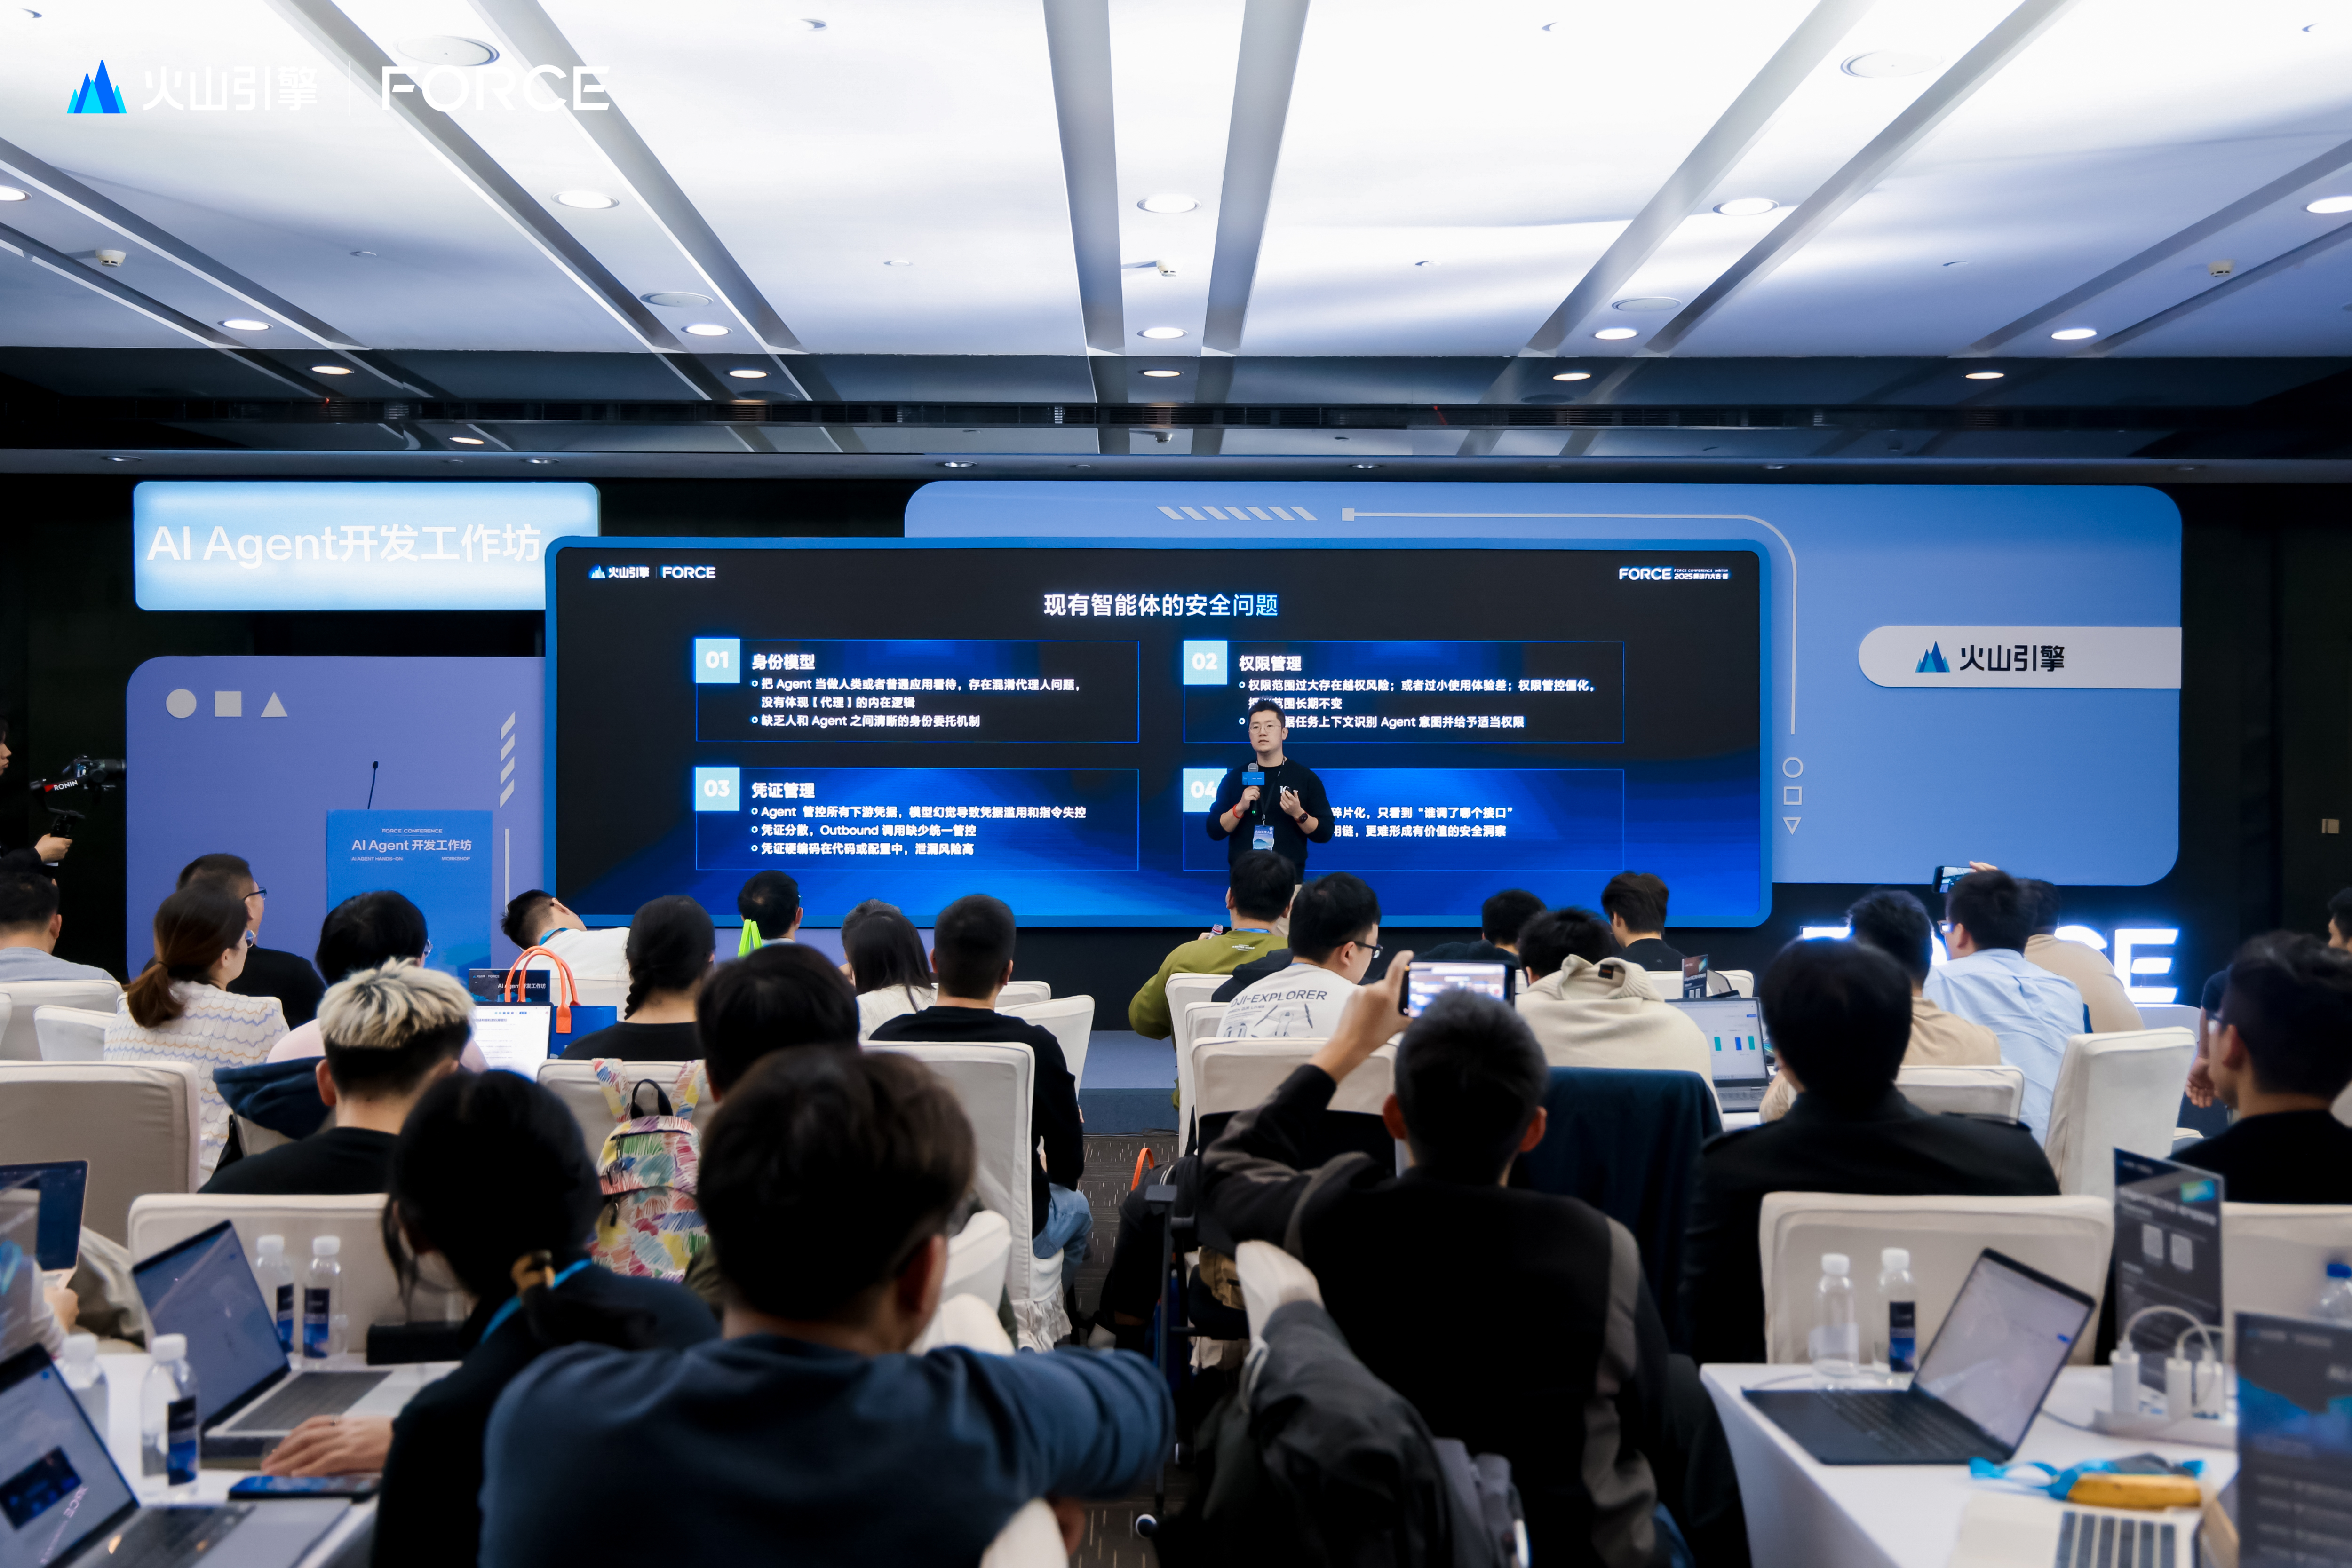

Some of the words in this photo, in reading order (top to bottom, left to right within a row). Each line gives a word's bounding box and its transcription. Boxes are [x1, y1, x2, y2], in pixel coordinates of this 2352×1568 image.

[147, 526, 191, 561] AI
[608, 566, 650, 578] 火山引擎
[662, 566, 716, 579] FORCE
[1618, 568, 1672, 580] FORCE
[1043, 593, 1278, 617] 现有智能体的安全问题
[706, 651, 728, 668] 01
[752, 653, 815, 670] 身份模型
[1192, 653, 1217, 670] 02
[1239, 655, 1302, 672] 权限管理
[1960, 644, 2065, 672] 火山引擎
[761, 677, 774, 690] 把
[776, 678, 812, 692] Agent
[1248, 697, 1343, 710] 范围长期不变
[761, 714, 809, 727] 缺乏人和
[811, 715, 848, 729] Agent
[850, 714, 980, 728] 之间清晰的身份委托机制
[1285, 715, 1377, 728] 据任务上下文识别
[1381, 716, 1416, 730] Agent
[1418, 715, 1525, 729] 意图并给予适当权限
[53, 780, 78, 791] RONIN
[704, 780, 730, 797] 03
[752, 782, 815, 799] 凭证管理
[1191, 781, 1217, 799] 04
[761, 806, 797, 820] Agent
[882, 824, 977, 837] 调用缺少统一管控
[351, 839, 366, 850] AI
[368, 839, 409, 853] Agent
[411, 839, 472, 851] 开发工作坊
[1231, 990, 1327, 1007] DJI-EXPLORER
